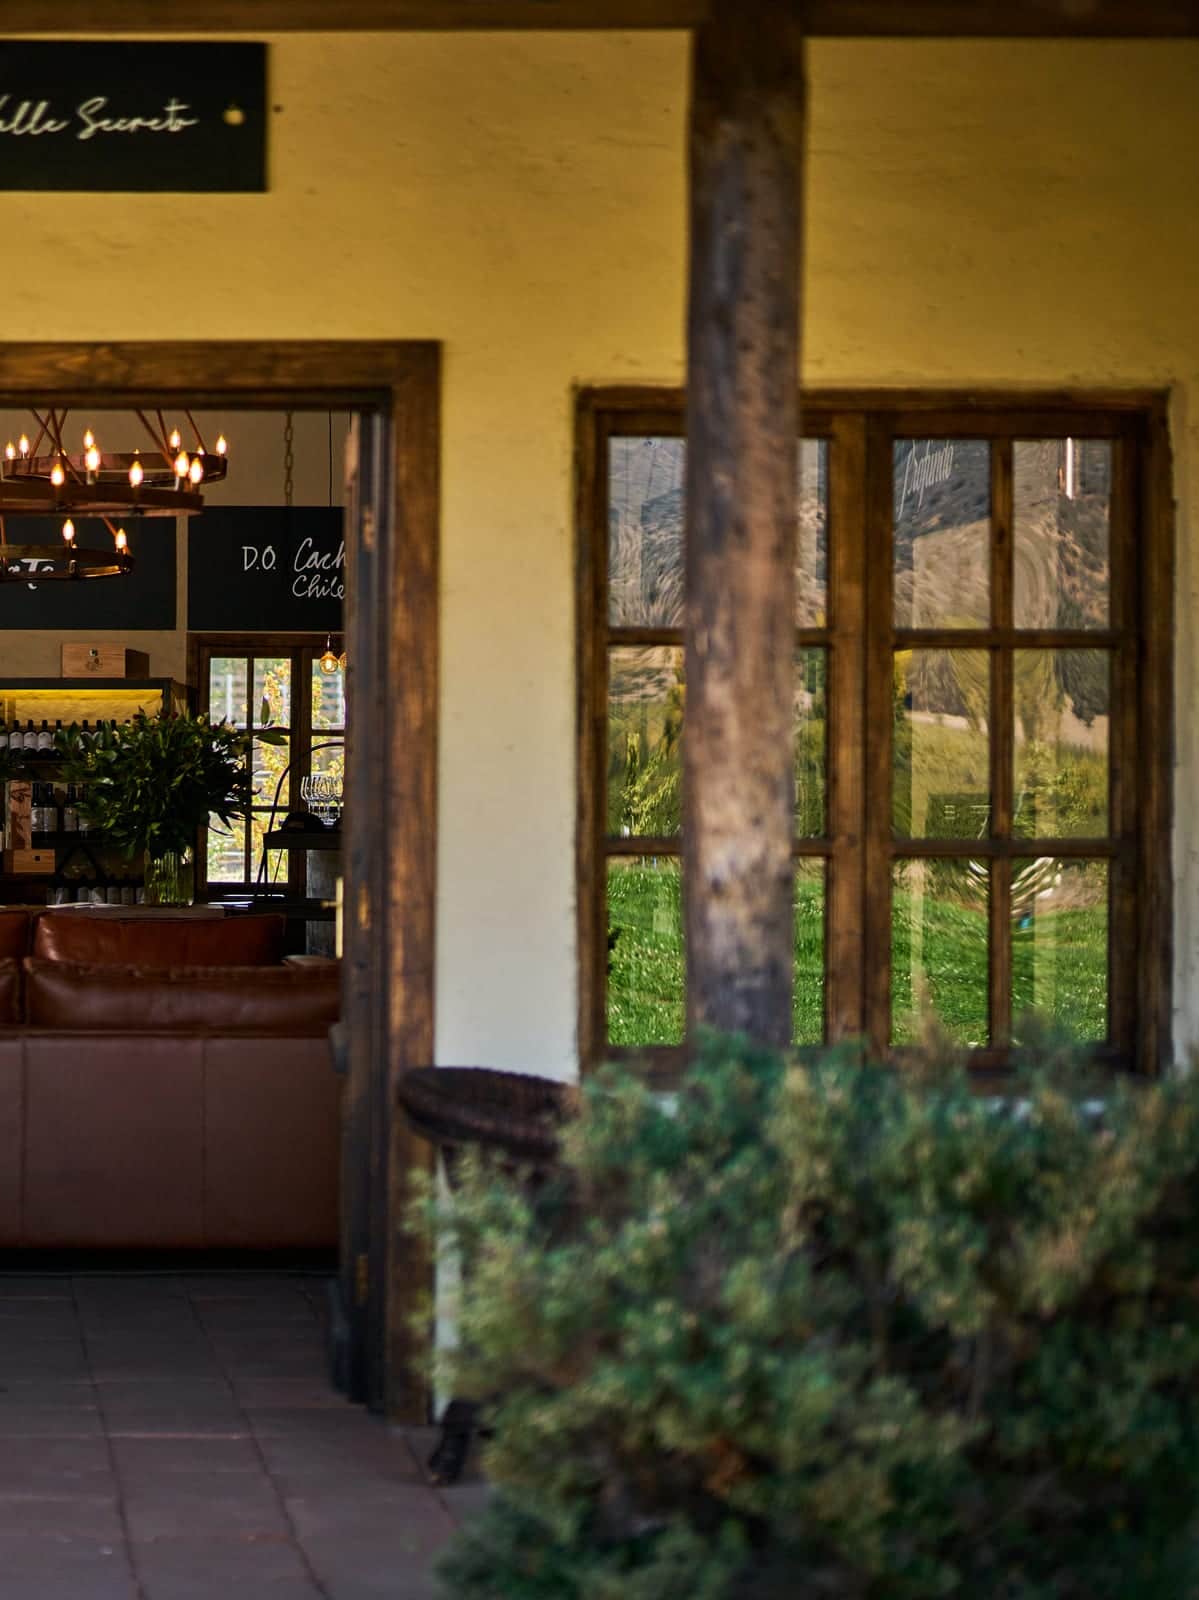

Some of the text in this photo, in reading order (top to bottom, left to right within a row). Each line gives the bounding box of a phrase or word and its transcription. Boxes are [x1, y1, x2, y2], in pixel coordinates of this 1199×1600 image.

[76, 97, 198, 140] Secreto
[241, 545, 277, 571] D.O.
[292, 574, 346, 600] Chile
